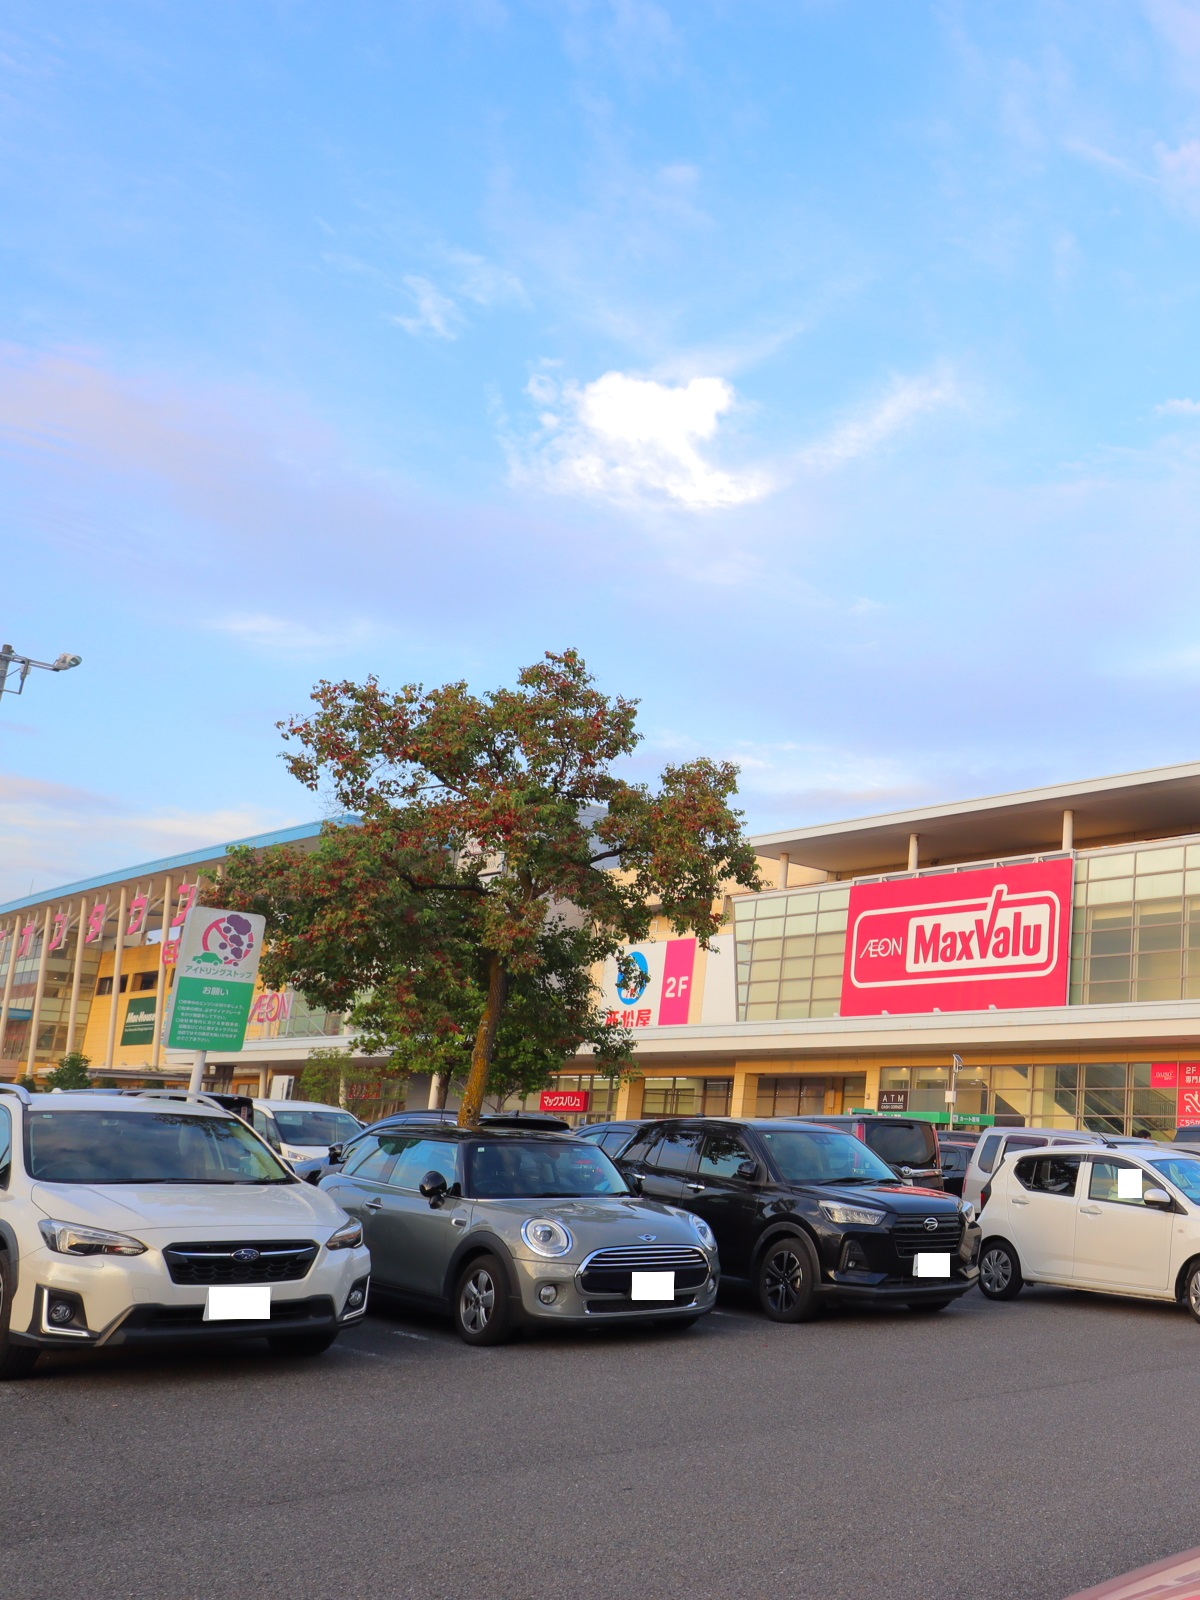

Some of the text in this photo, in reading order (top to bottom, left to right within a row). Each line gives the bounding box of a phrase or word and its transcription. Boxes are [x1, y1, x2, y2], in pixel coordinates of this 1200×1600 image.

[913, 889, 1042, 965] MaxValu
[202, 986, 229, 996] お願い
[665, 976, 689, 998] 2F
[1185, 1066, 1197, 1075] 2F
[543, 1095, 581, 1107] マックスバリュ
[882, 1094, 904, 1102] ATM
